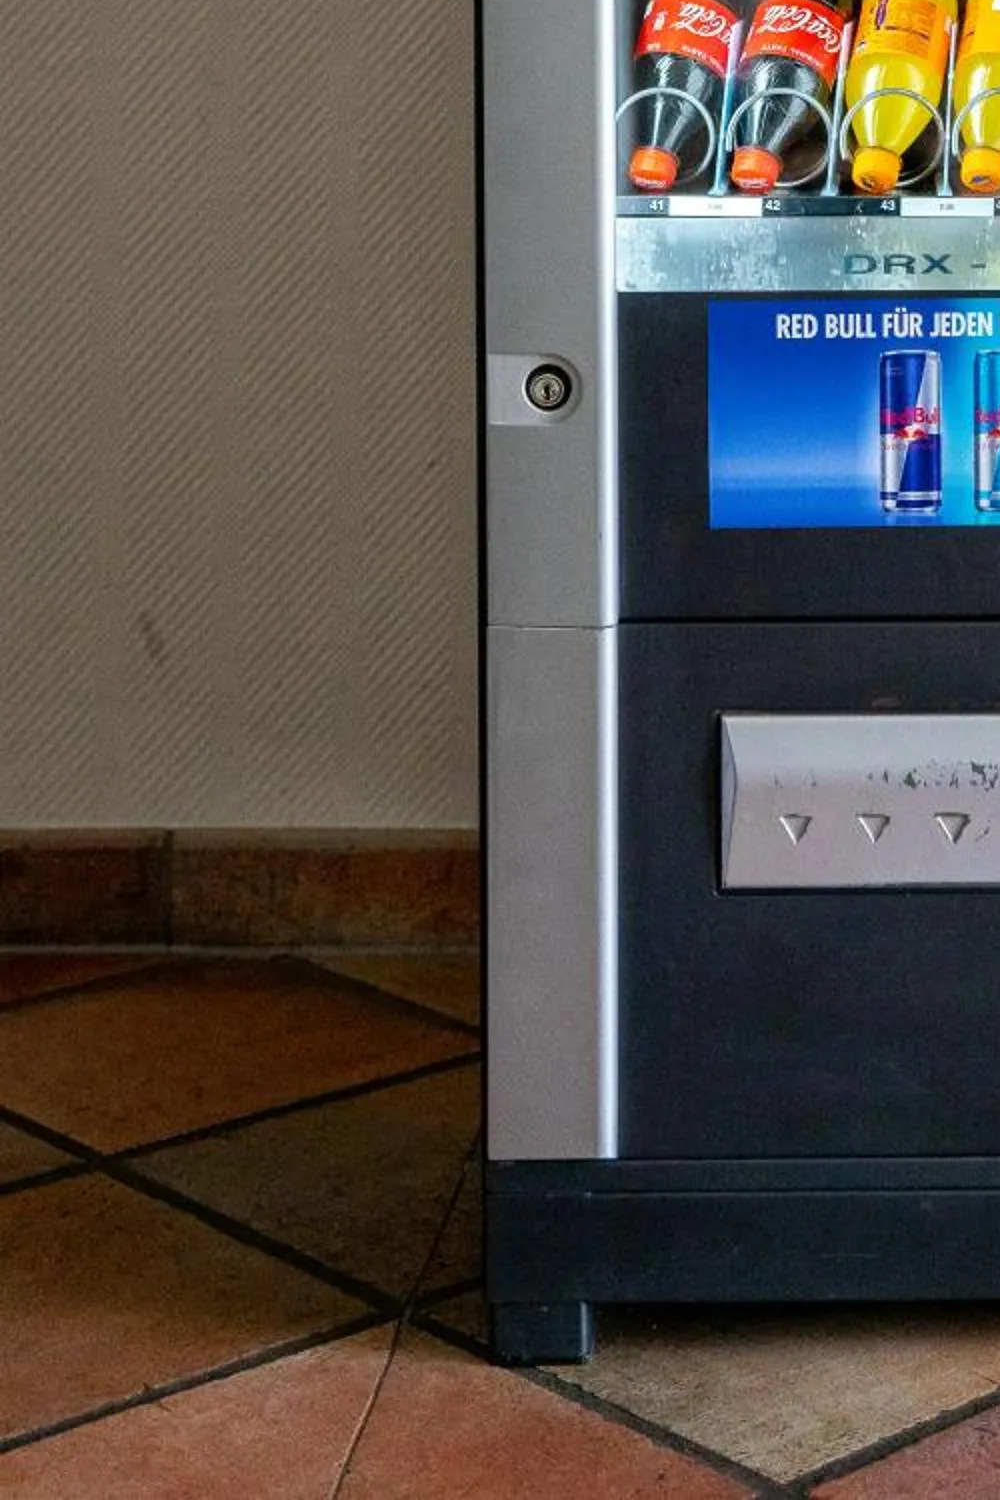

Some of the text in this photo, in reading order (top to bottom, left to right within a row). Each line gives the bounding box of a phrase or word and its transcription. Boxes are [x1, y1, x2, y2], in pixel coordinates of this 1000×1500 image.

[671, 1, 732, 46] a-Cola
[757, 5, 840, 53] Coca-Cola
[650, 201, 664, 211] 41
[766, 200, 781, 211] 42
[880, 200, 895, 211] 43
[844, 254, 952, 275] DRX
[776, 313, 818, 340] RED
[825, 312, 876, 339] BULL
[882, 307, 923, 338] FÜR
[929, 312, 993, 337] JEDEN
